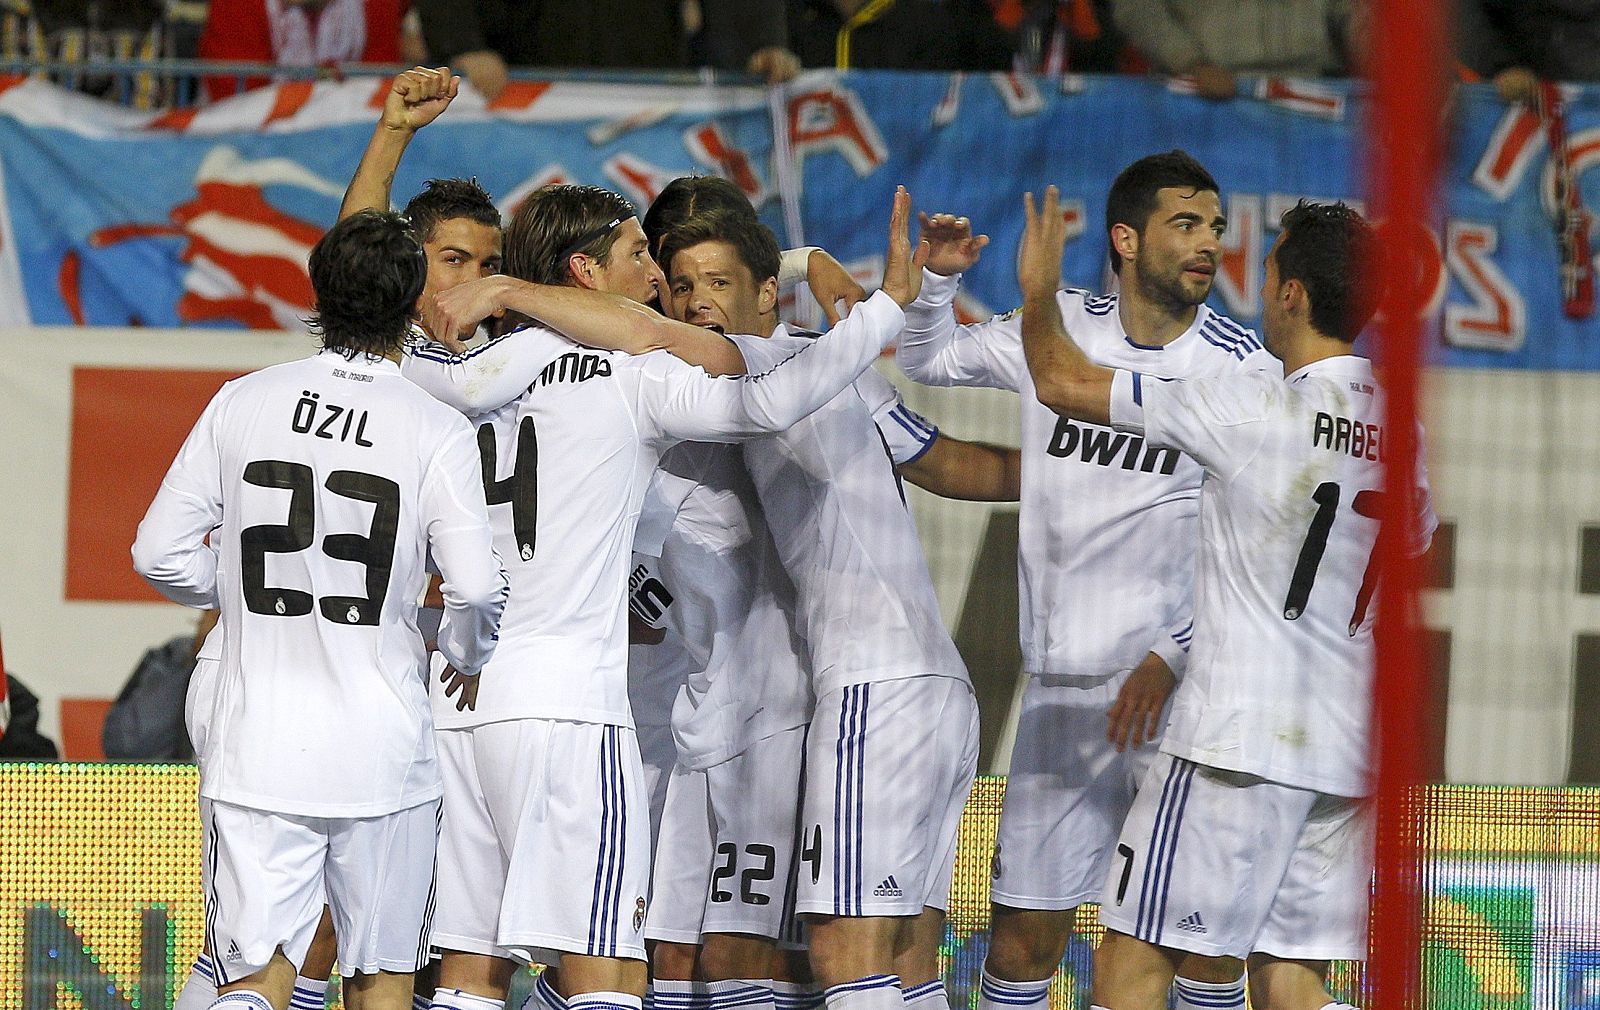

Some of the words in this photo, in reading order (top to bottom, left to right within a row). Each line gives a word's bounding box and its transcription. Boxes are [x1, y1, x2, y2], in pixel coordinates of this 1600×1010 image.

[332, 368, 348, 378] REAL
[291, 389, 374, 447] ÖZIL
[1046, 414, 1182, 476] bwin
[477, 415, 538, 562] 4
[240, 460, 401, 626] 23
[711, 842, 776, 906] 22
[873, 888, 903, 897] adidas
